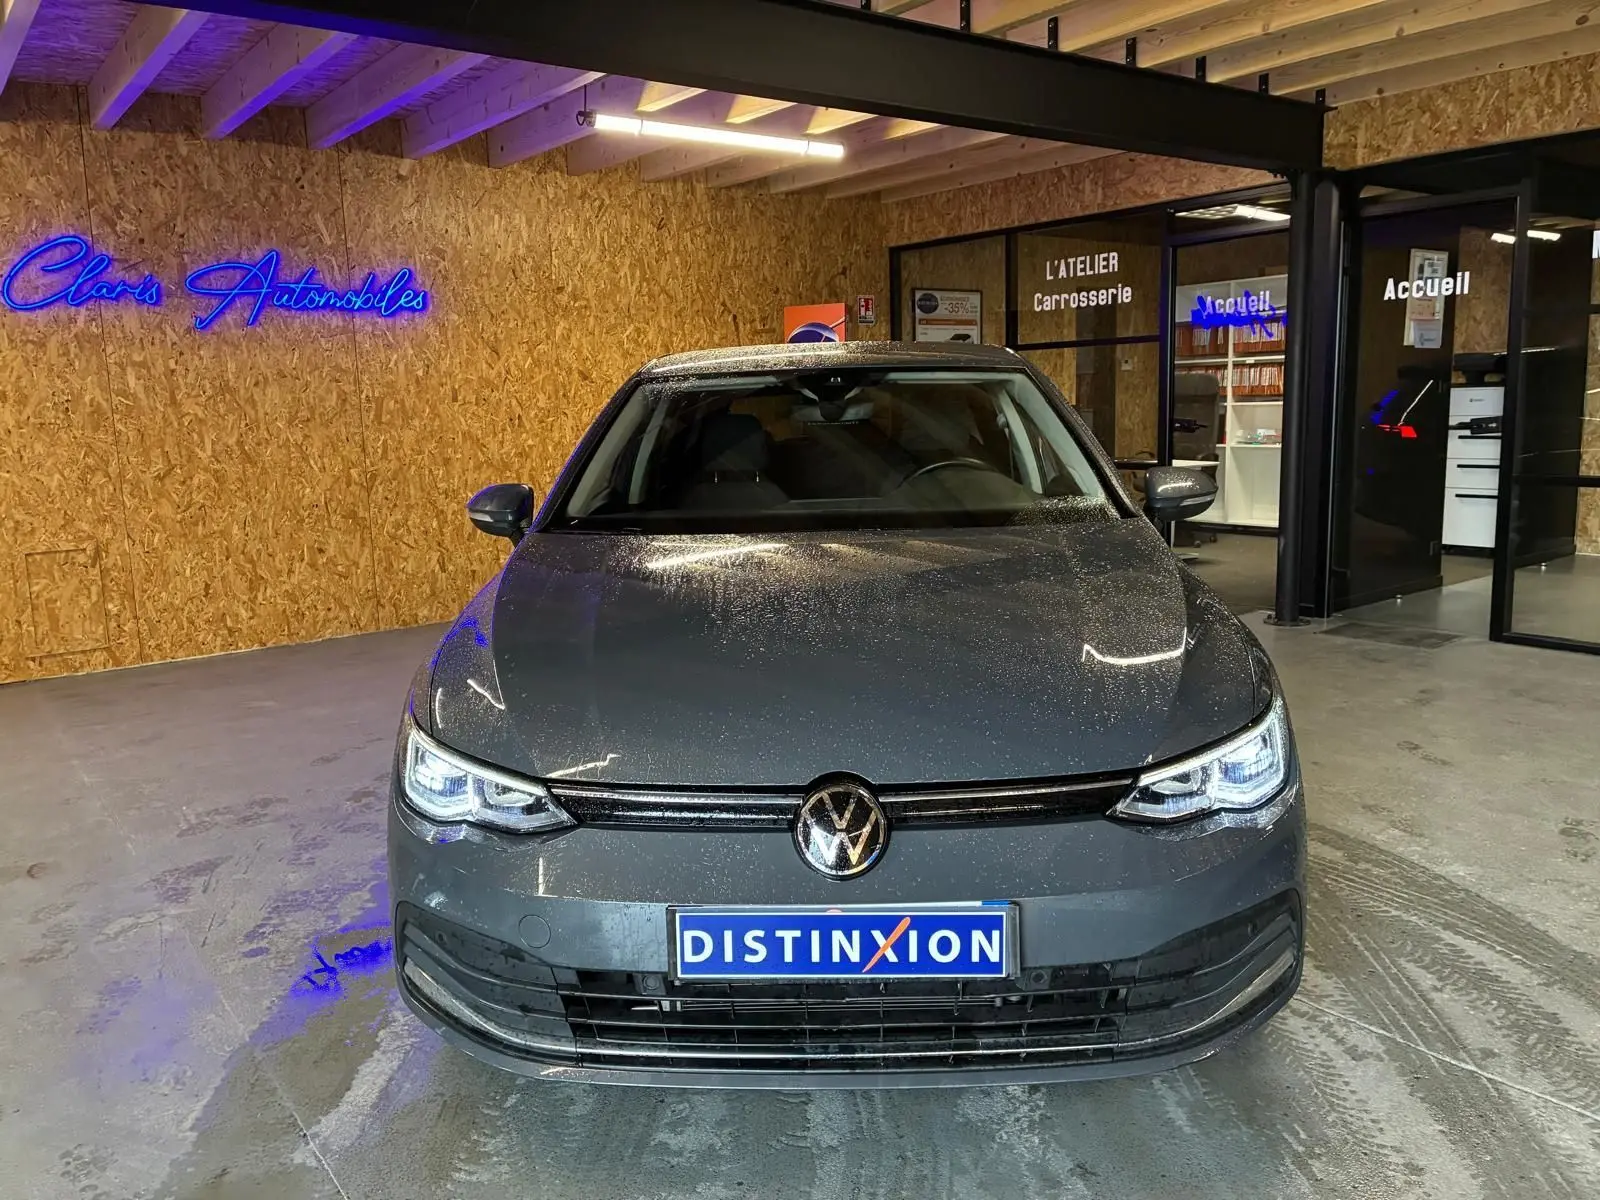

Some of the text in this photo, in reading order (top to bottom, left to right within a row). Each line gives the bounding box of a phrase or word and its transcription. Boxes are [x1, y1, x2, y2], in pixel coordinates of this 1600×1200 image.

[1046, 251, 1119, 280] L'ATELIER
[2, 235, 427, 329] Claris Automobiles
[1383, 270, 1470, 300] Accueil
[1034, 283, 1132, 312] Carrosserie
[1204, 289, 1270, 316] Accueil
[683, 916, 1000, 973] DISTINXION
